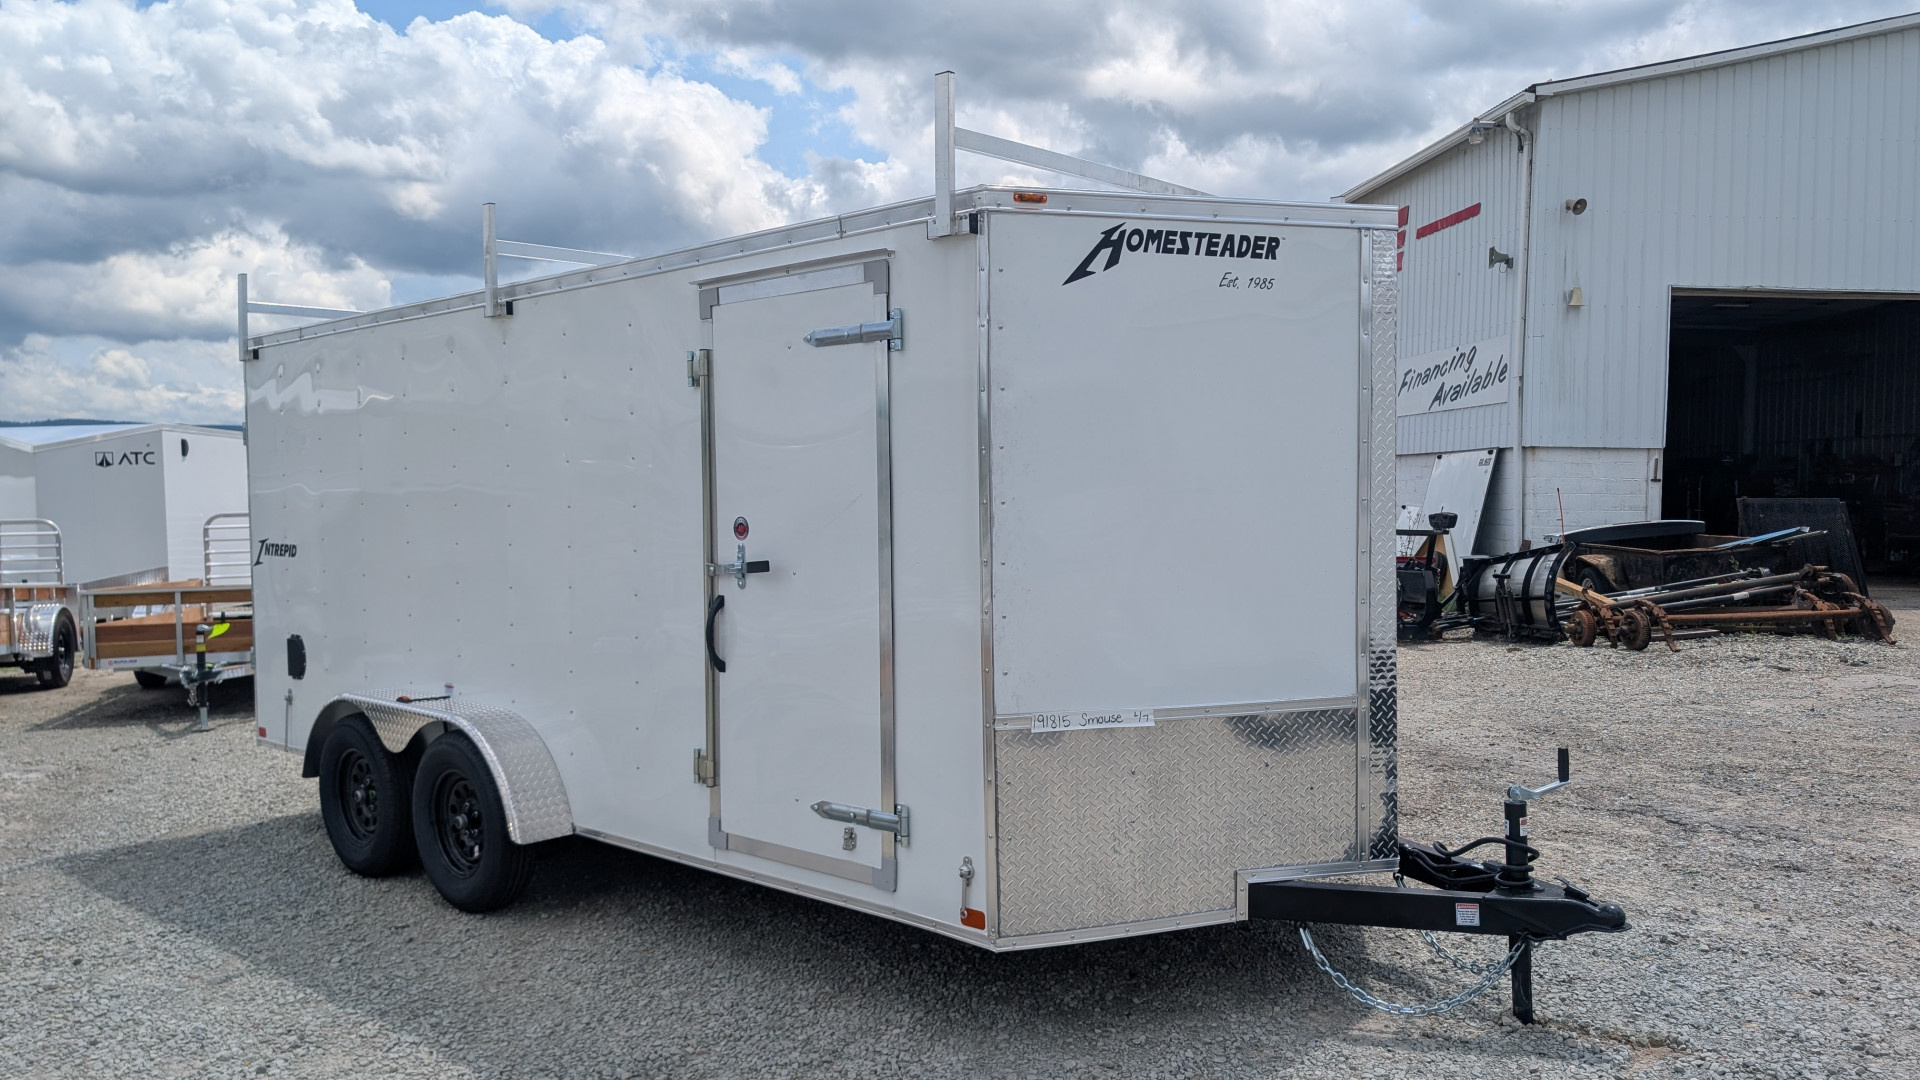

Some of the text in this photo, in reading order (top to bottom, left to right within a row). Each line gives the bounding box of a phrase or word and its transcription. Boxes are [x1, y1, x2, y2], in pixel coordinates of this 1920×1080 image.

[1062, 222, 1281, 286] HOMESTEADER
[1219, 272, 1275, 290] Est. 1985
[1398, 346, 1477, 397] Financing
[1428, 354, 1508, 411] Available
[118, 452, 155, 465] ATC
[253, 537, 297, 567] INTREPID
[1079, 713, 1123, 727] Smouse
